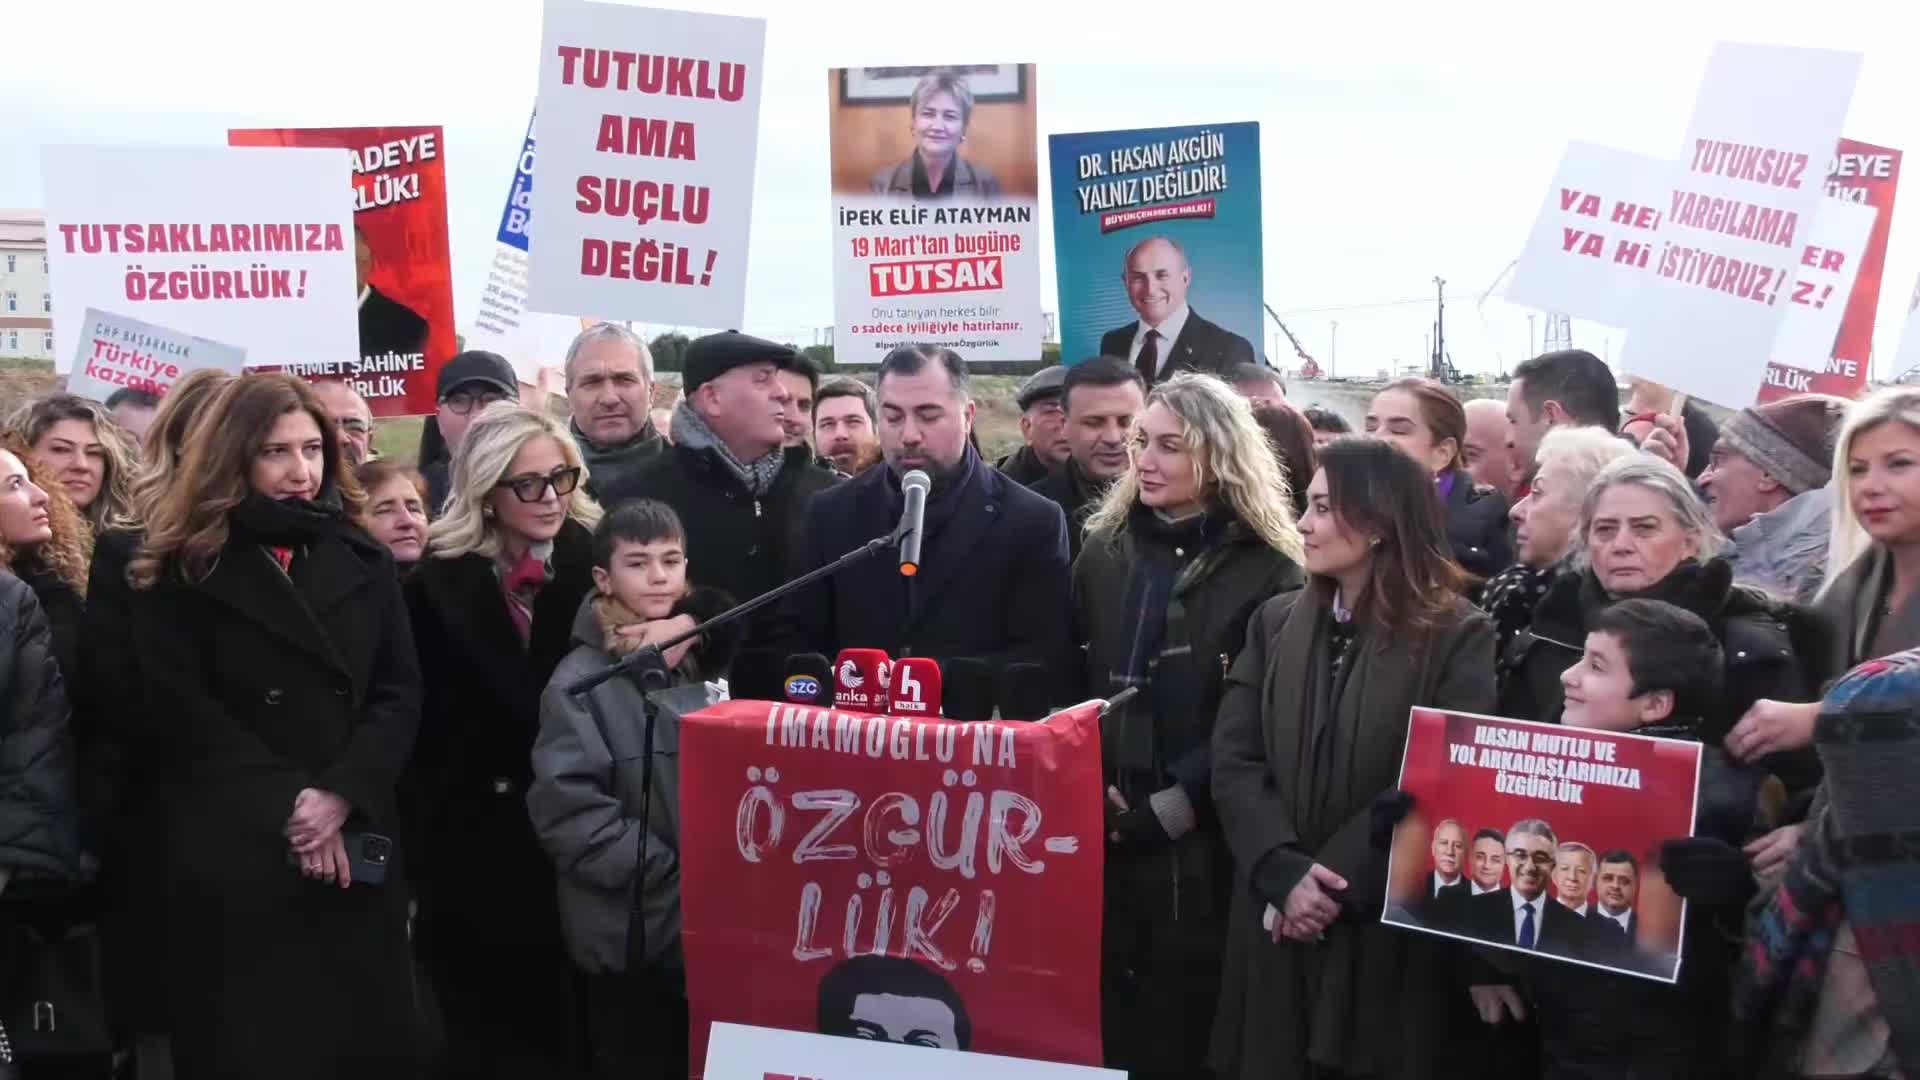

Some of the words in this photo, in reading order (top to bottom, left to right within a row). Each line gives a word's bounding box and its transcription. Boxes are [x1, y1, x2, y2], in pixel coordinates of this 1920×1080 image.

[558, 45, 746, 102] TUTUKLU
[596, 114, 696, 161] AMA
[1080, 153, 1107, 178] DR.
[1111, 144, 1164, 173] HASAN
[1168, 130, 1224, 164] AKGÜN
[1691, 138, 1809, 190] TUTUKSUZ
[576, 175, 710, 225] SUÇLU
[1079, 179, 1143, 212] YALNIZ
[1143, 162, 1227, 201] DEĞİLDİR!
[840, 206, 884, 226] İPEK
[890, 204, 928, 225] ELİF
[934, 207, 1031, 225] ATAYMAN
[1560, 188, 1601, 217] YA
[1611, 200, 1661, 231] HE
[1668, 190, 1798, 248] YARGILAMA
[59, 224, 344, 253] TUTSAKLARIMIZA
[851, 237, 869, 257] 19
[875, 234, 949, 257] Mart'tan
[955, 231, 1021, 255] bugüne
[1562, 227, 1604, 258] YA
[125, 265, 308, 300] ÖZGÜRLÜK!
[580, 237, 718, 287] DEĞİL!
[872, 259, 999, 293] TUTSAK
[1657, 240, 1787, 306] İSTİYORUZ!
[862, 323, 903, 334] sadece
[907, 321, 959, 335] iyiliğiyle
[872, 307, 893, 319] Onu
[896, 308, 937, 321] tanıyan
[939, 306, 976, 318] herkes
[93, 339, 178, 378] Türkiye
[789, 682, 817, 694] SZC
[836, 689, 868, 702] anka
[1474, 725, 1529, 751] HASAN
[1532, 733, 1590, 759] MUTLU
[1594, 741, 1616, 762] VE
[1450, 743, 1477, 767] YOL
[1479, 749, 1640, 789] ARKADAŞLARIMIZA
[1495, 770, 1583, 804] ÖZGÜRLÜK
[735, 766, 1079, 878] ÖZGÜR-
[793, 871, 996, 973] LÜK!
